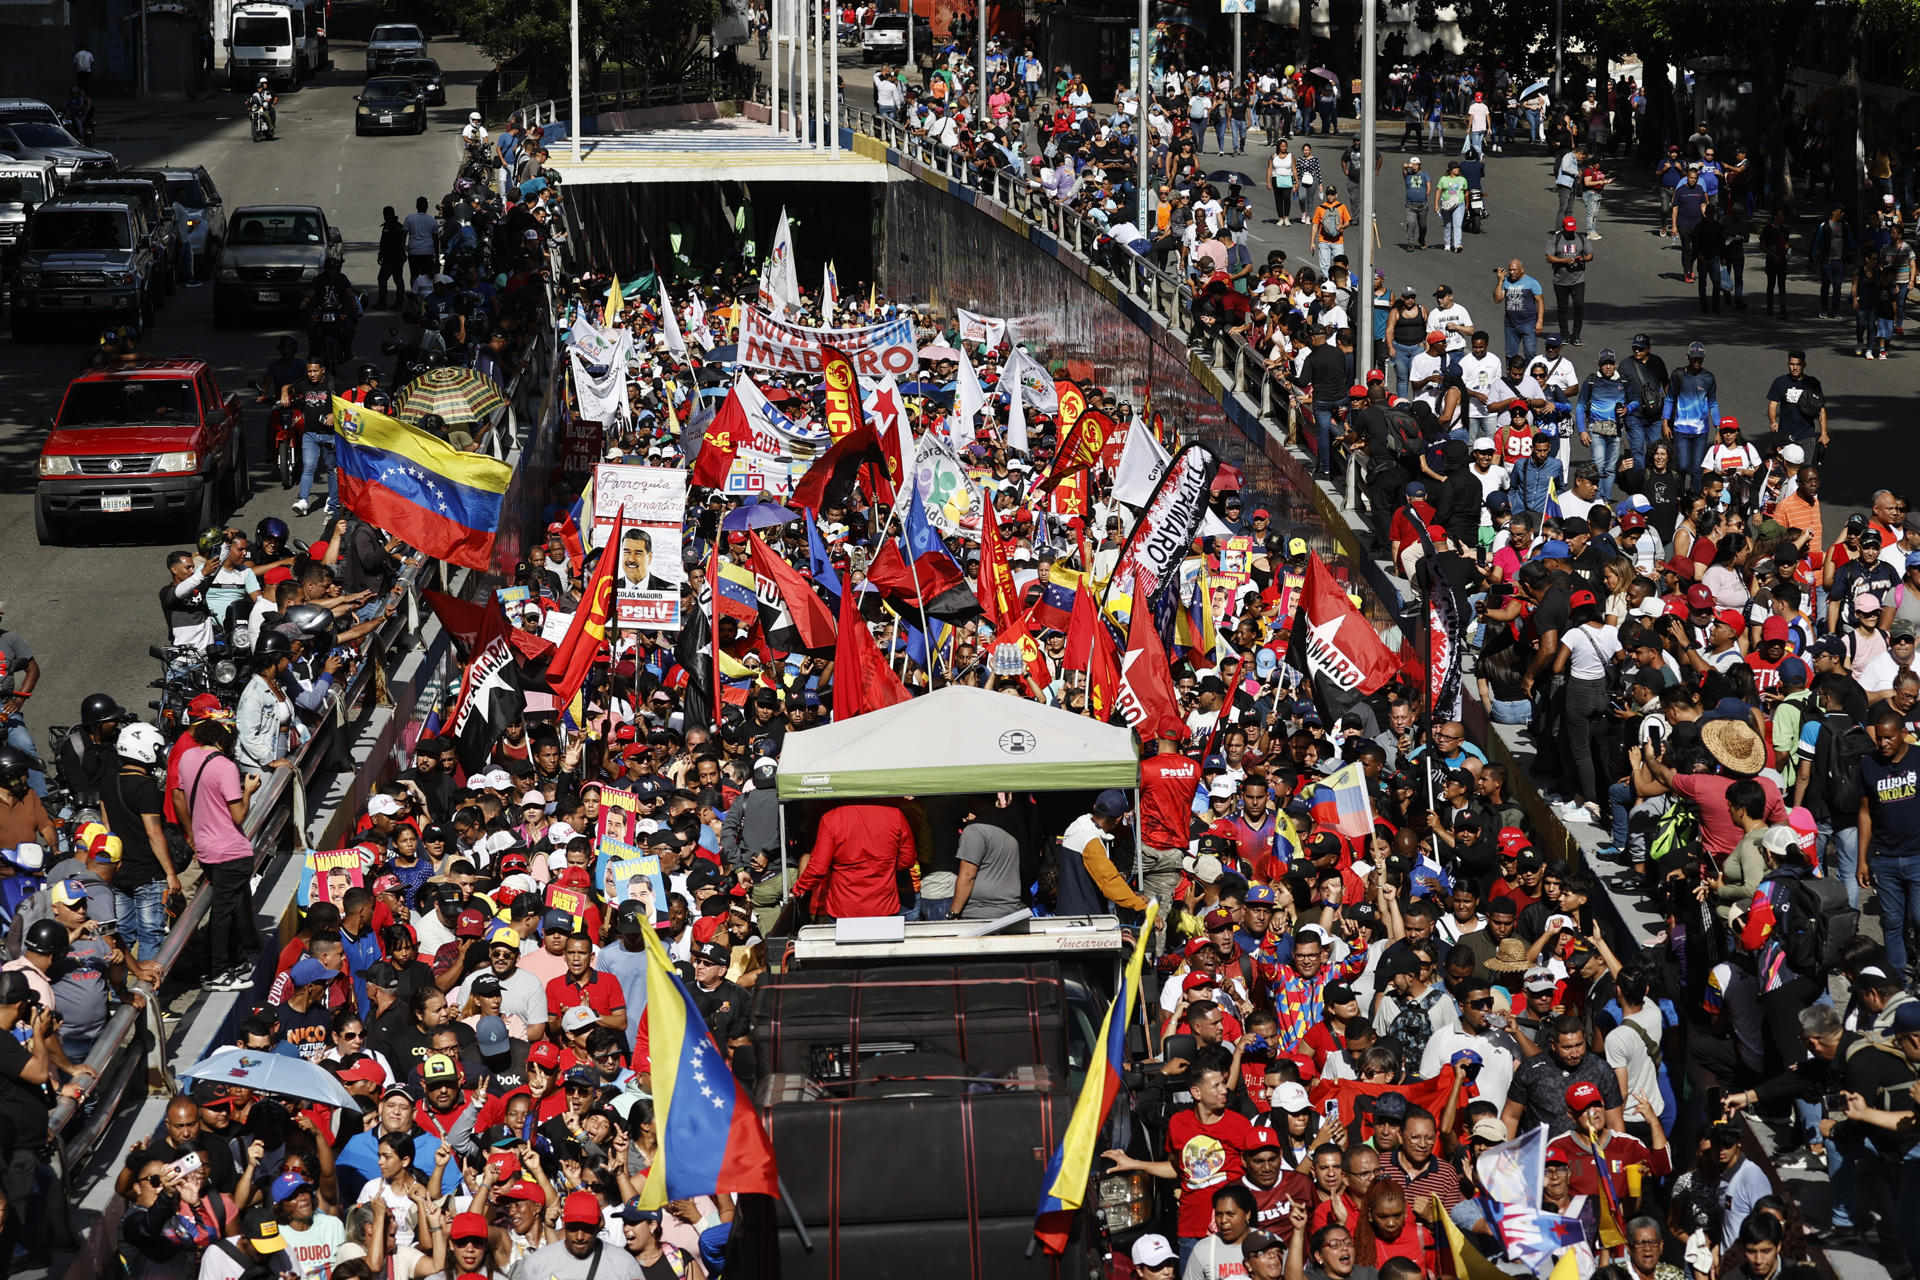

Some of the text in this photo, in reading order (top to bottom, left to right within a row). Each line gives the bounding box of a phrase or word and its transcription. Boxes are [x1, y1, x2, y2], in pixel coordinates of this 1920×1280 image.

[0, 171, 39, 179] CAPITAL
[871, 320, 913, 346] CON
[745, 336, 914, 375] MADRO
[566, 421, 598, 440] LUZ
[1507, 436, 1533, 457] 98
[599, 471, 672, 494] Parroquia
[637, 592, 663, 600] MADURO
[601, 790, 636, 813] MADURO
[316, 853, 360, 872] MADURO
[615, 860, 659, 881] MADURO
[267, 971, 290, 1007] EZUELA
[286, 1025, 326, 1044] NICO
[498, 1074, 521, 1085] bok
[1258, 1131, 1268, 1142] V
[1257, 1201, 1291, 1222] SUV
[294, 1244, 331, 1262] ADURO
